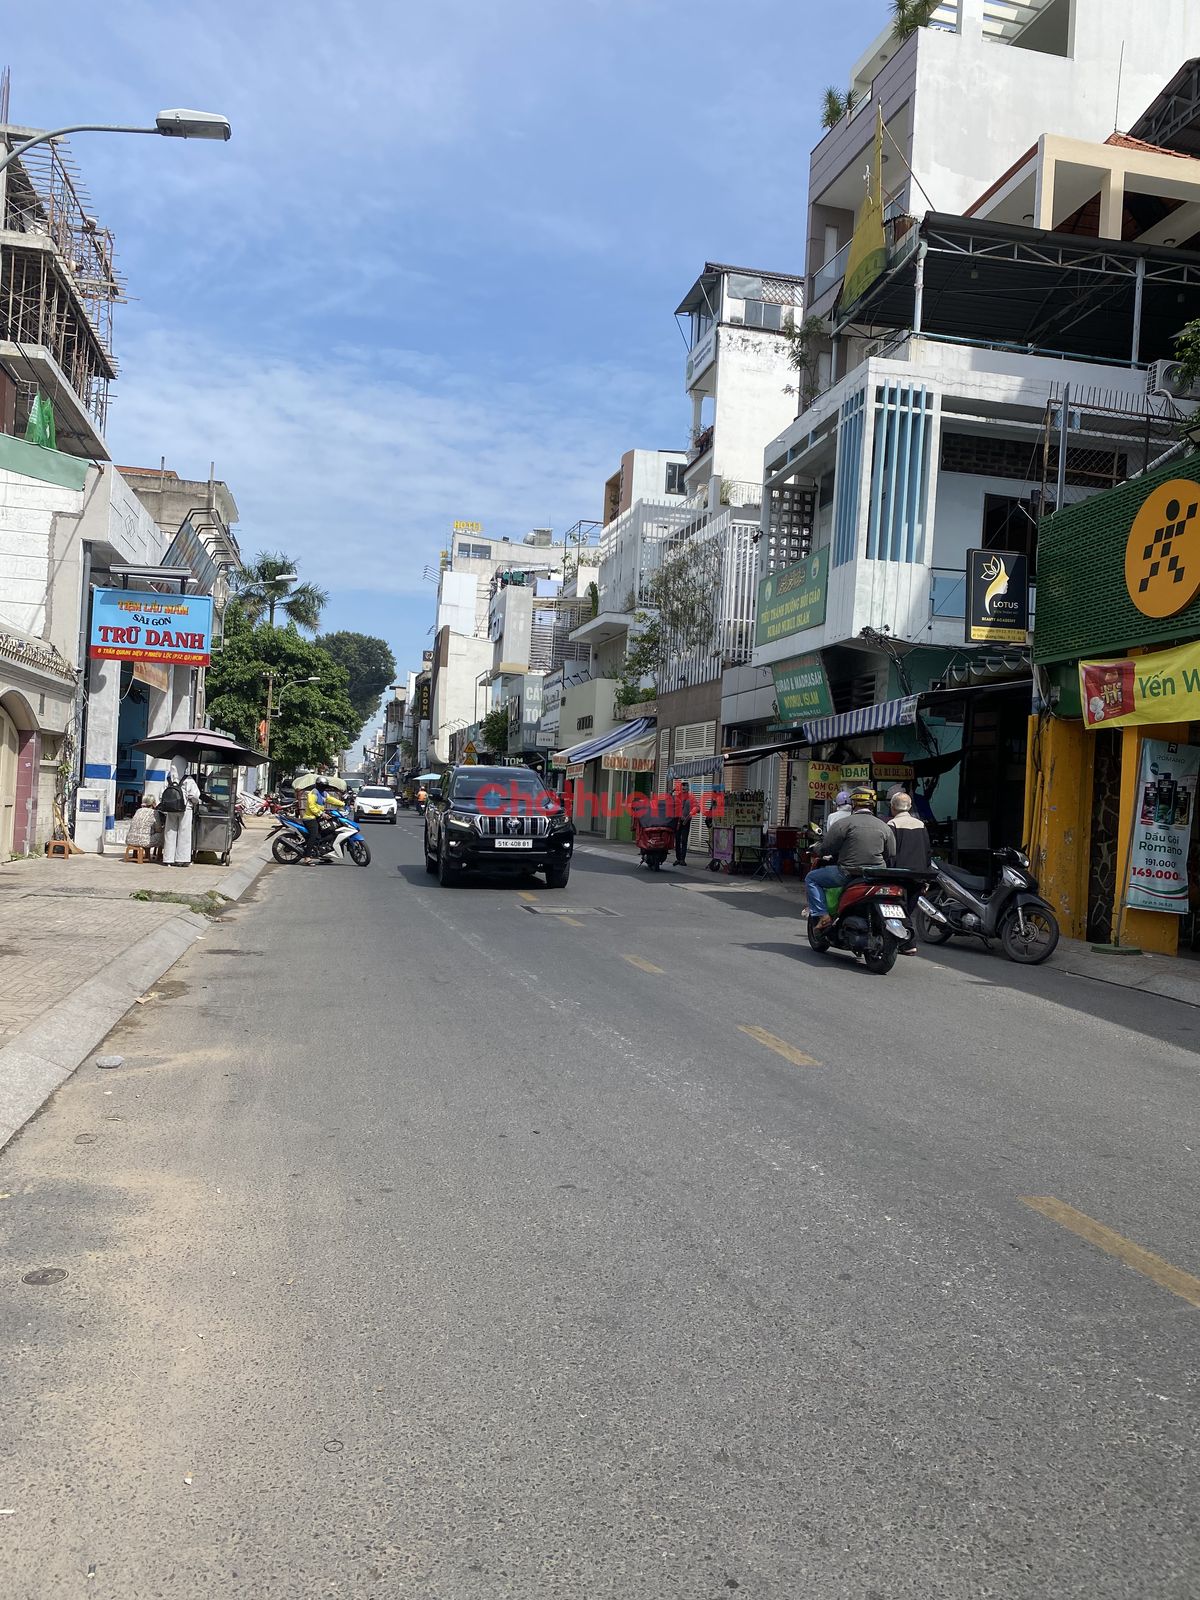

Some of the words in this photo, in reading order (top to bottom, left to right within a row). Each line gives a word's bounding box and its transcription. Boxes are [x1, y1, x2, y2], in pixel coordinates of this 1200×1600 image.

[994, 601, 1019, 609] LOTUS
[145, 629, 205, 649] DANH
[1138, 671, 1176, 699] Yến
[1156, 754, 1186, 764] ROMANO
[811, 763, 839, 772] ADAM
[815, 791, 833, 799] 25K
[1145, 831, 1166, 843] Dầu
[1139, 841, 1183, 856] Romano
[1145, 858, 1177, 869] 191.000
[1132, 867, 1179, 881] 149.000
